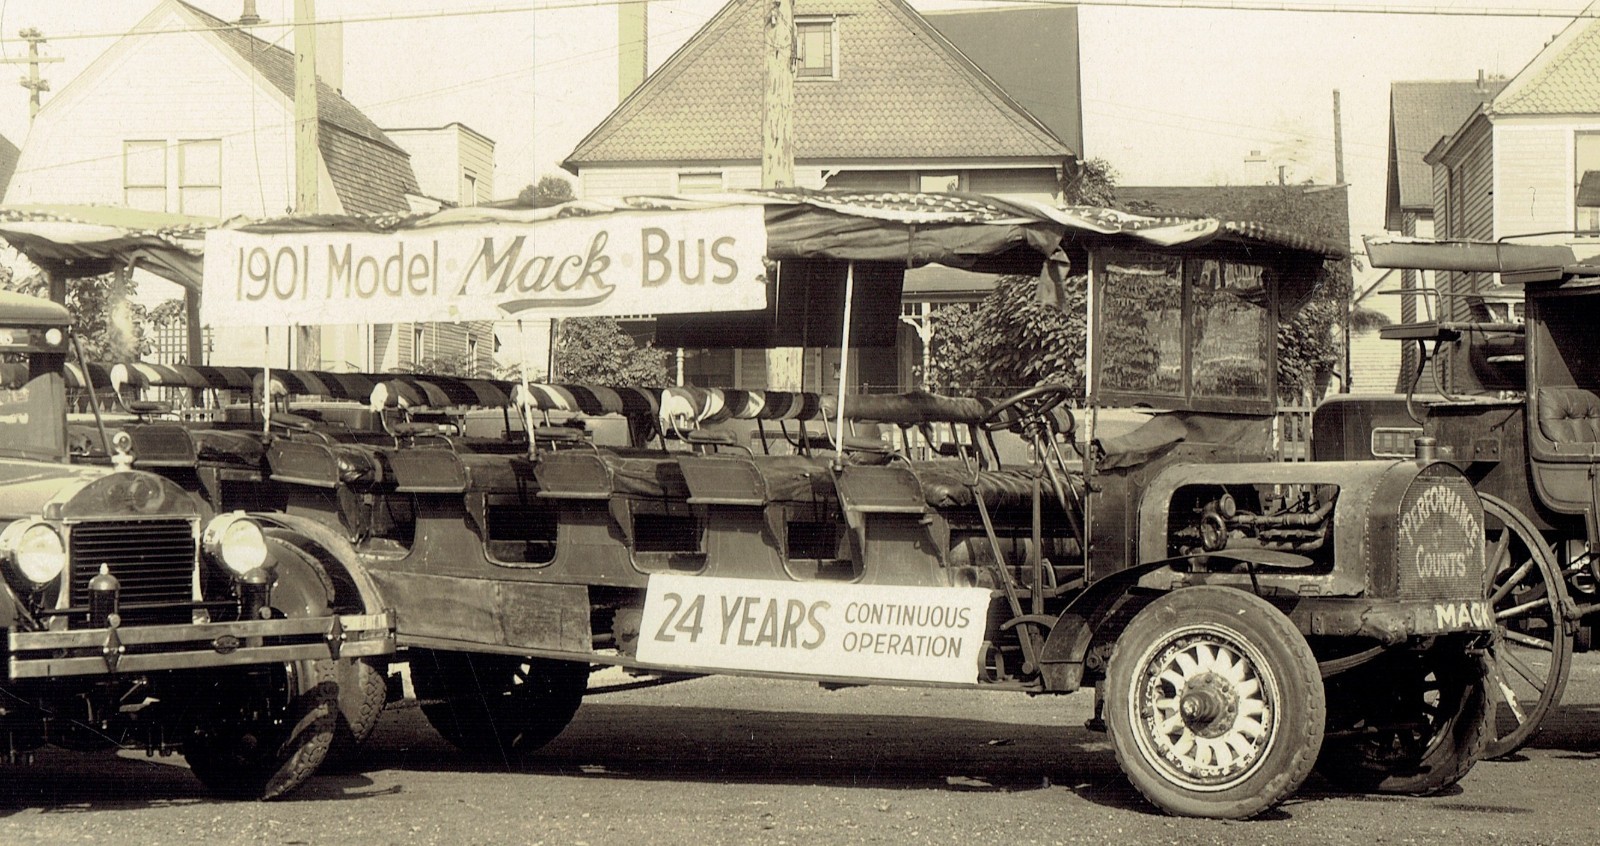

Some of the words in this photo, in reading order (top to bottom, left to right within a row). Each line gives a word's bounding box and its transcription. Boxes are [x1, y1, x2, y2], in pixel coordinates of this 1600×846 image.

[236, 245, 310, 301] 1901
[326, 239, 438, 299] Model
[456, 230, 617, 315] Mack
[642, 228, 739, 287] Bus
[654, 592, 706, 643] 24
[719, 595, 830, 650] YEARS
[844, 602, 970, 628] CONTINUOUS
[1434, 604, 1491, 629] MACK
[842, 632, 962, 658] OPERATION
